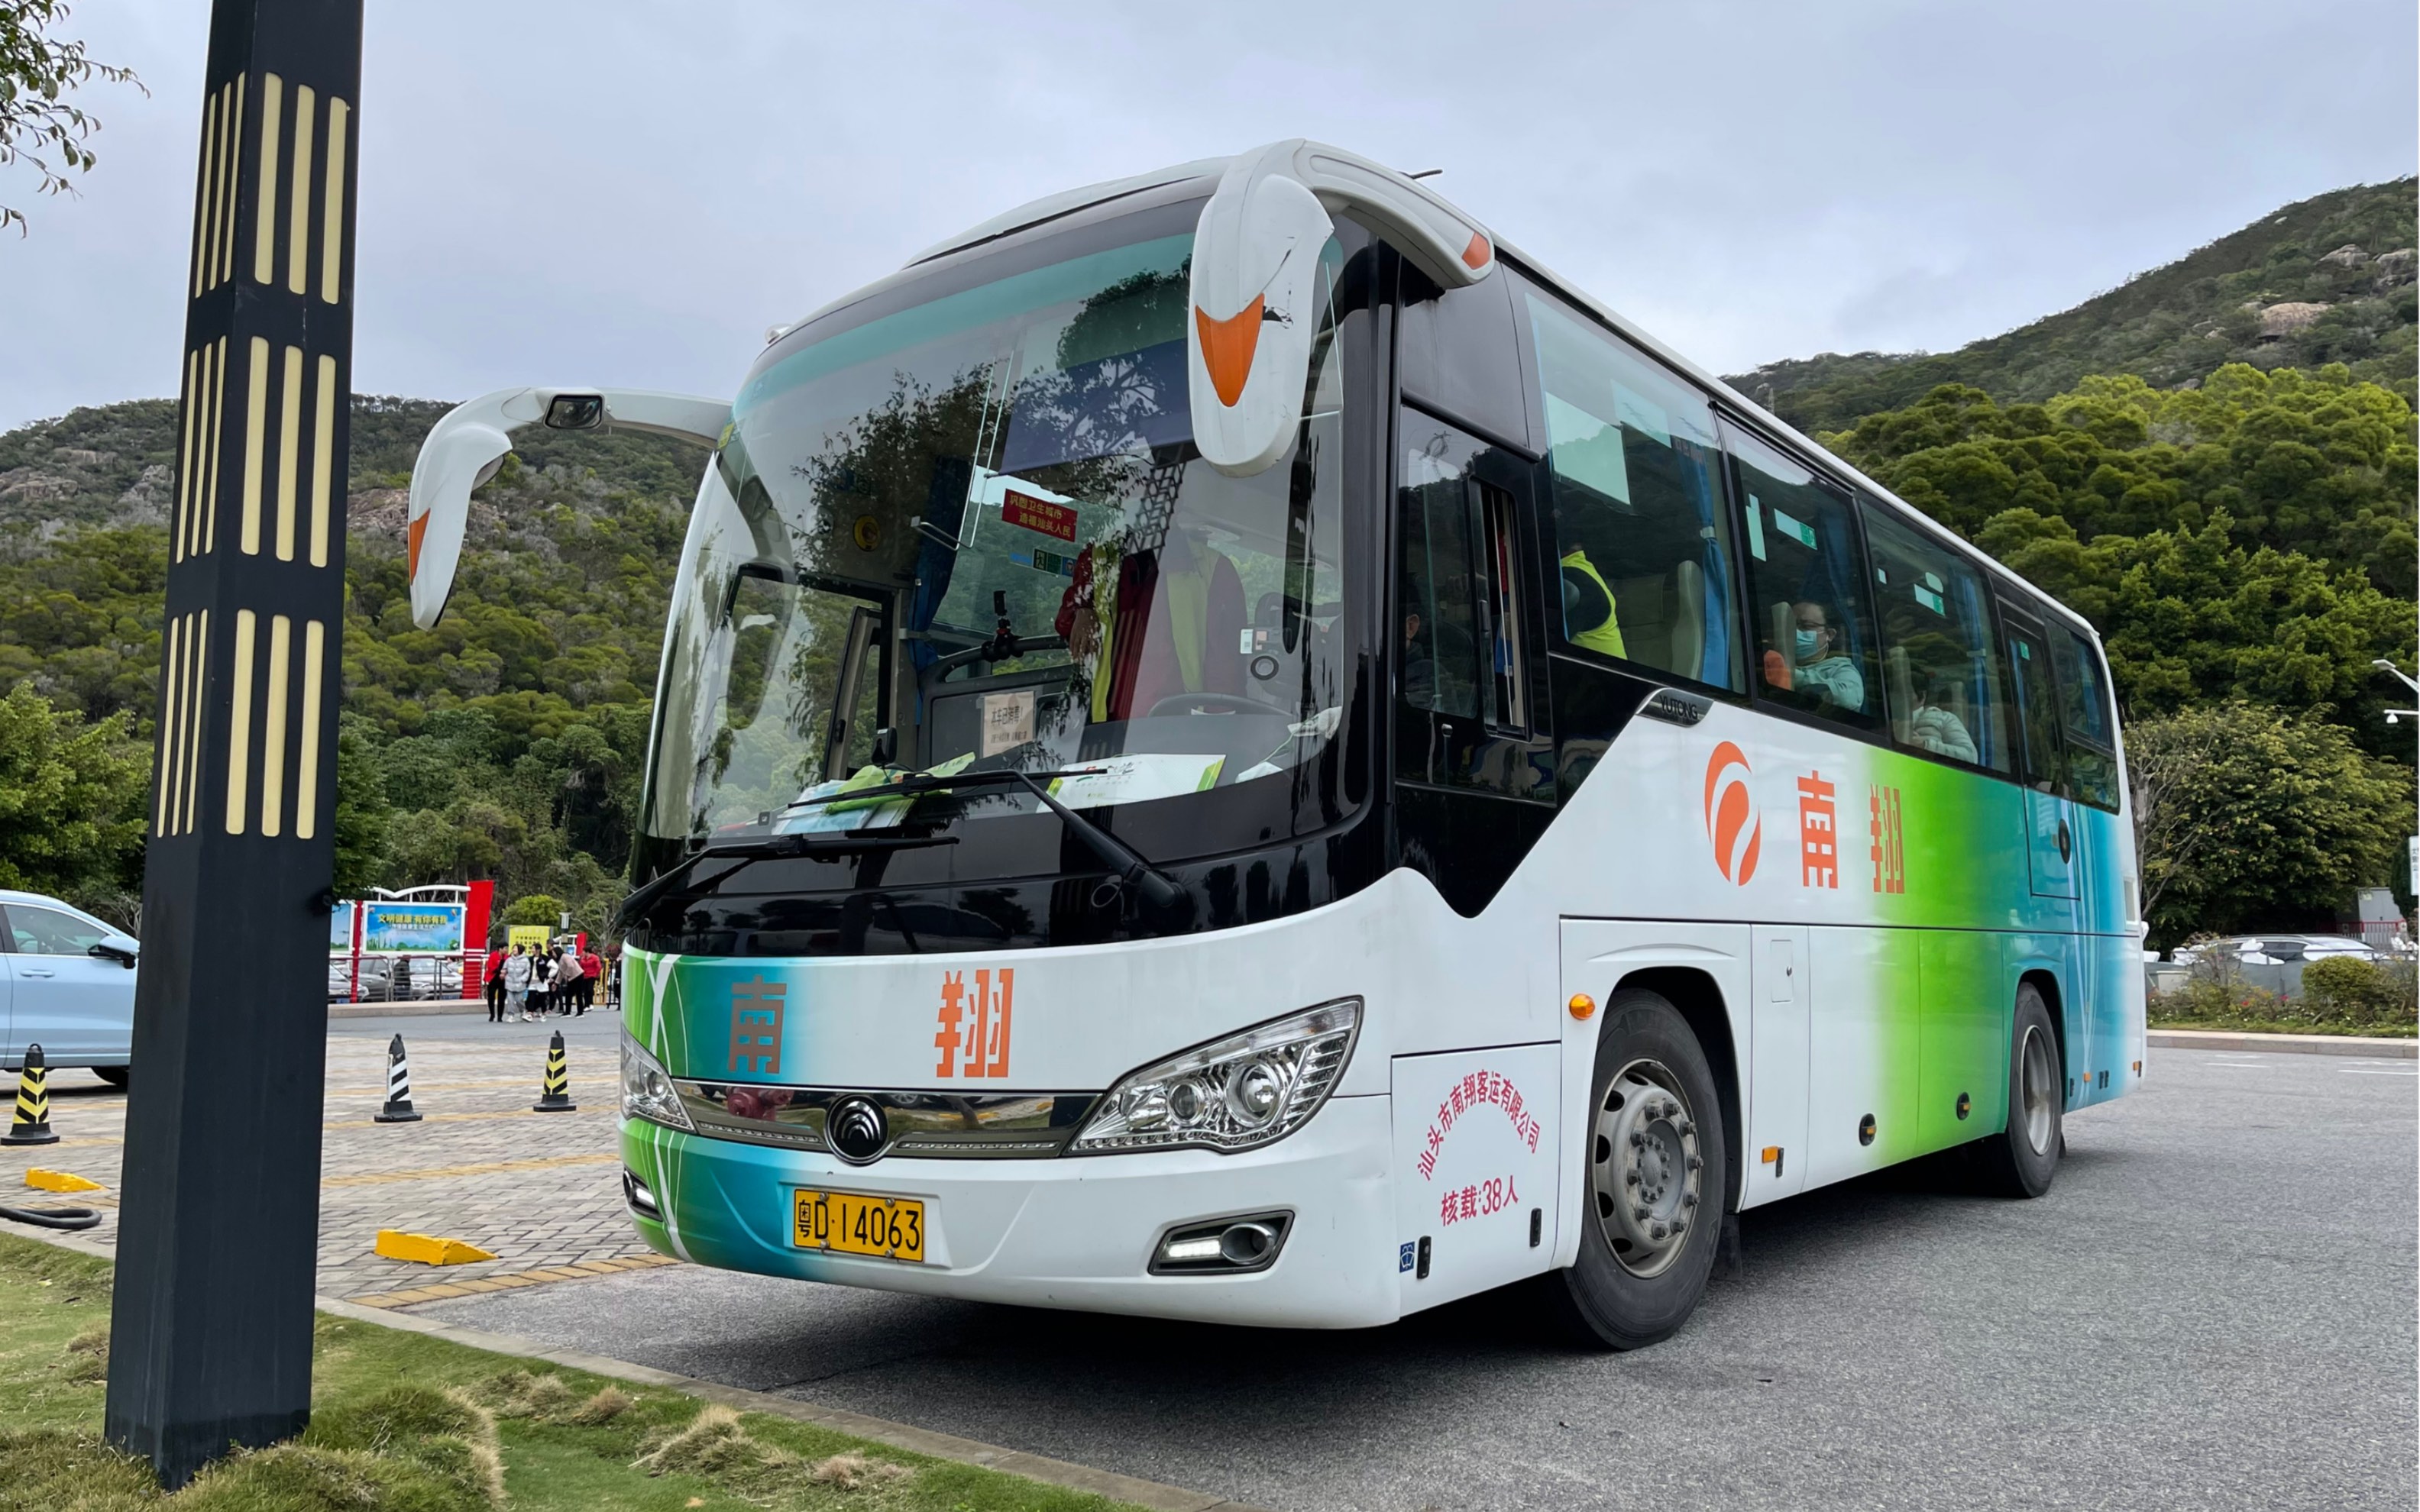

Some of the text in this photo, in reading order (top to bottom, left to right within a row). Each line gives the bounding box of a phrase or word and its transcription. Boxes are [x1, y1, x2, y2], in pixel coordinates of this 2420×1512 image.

[1010, 494, 1063, 519] 巩固卫生城市
[1019, 511, 1071, 538] 造福汕头人民
[1659, 694, 1698, 719] YUTONG
[1418, 1069, 1540, 1181] 汕头市南翔客运有限公司
